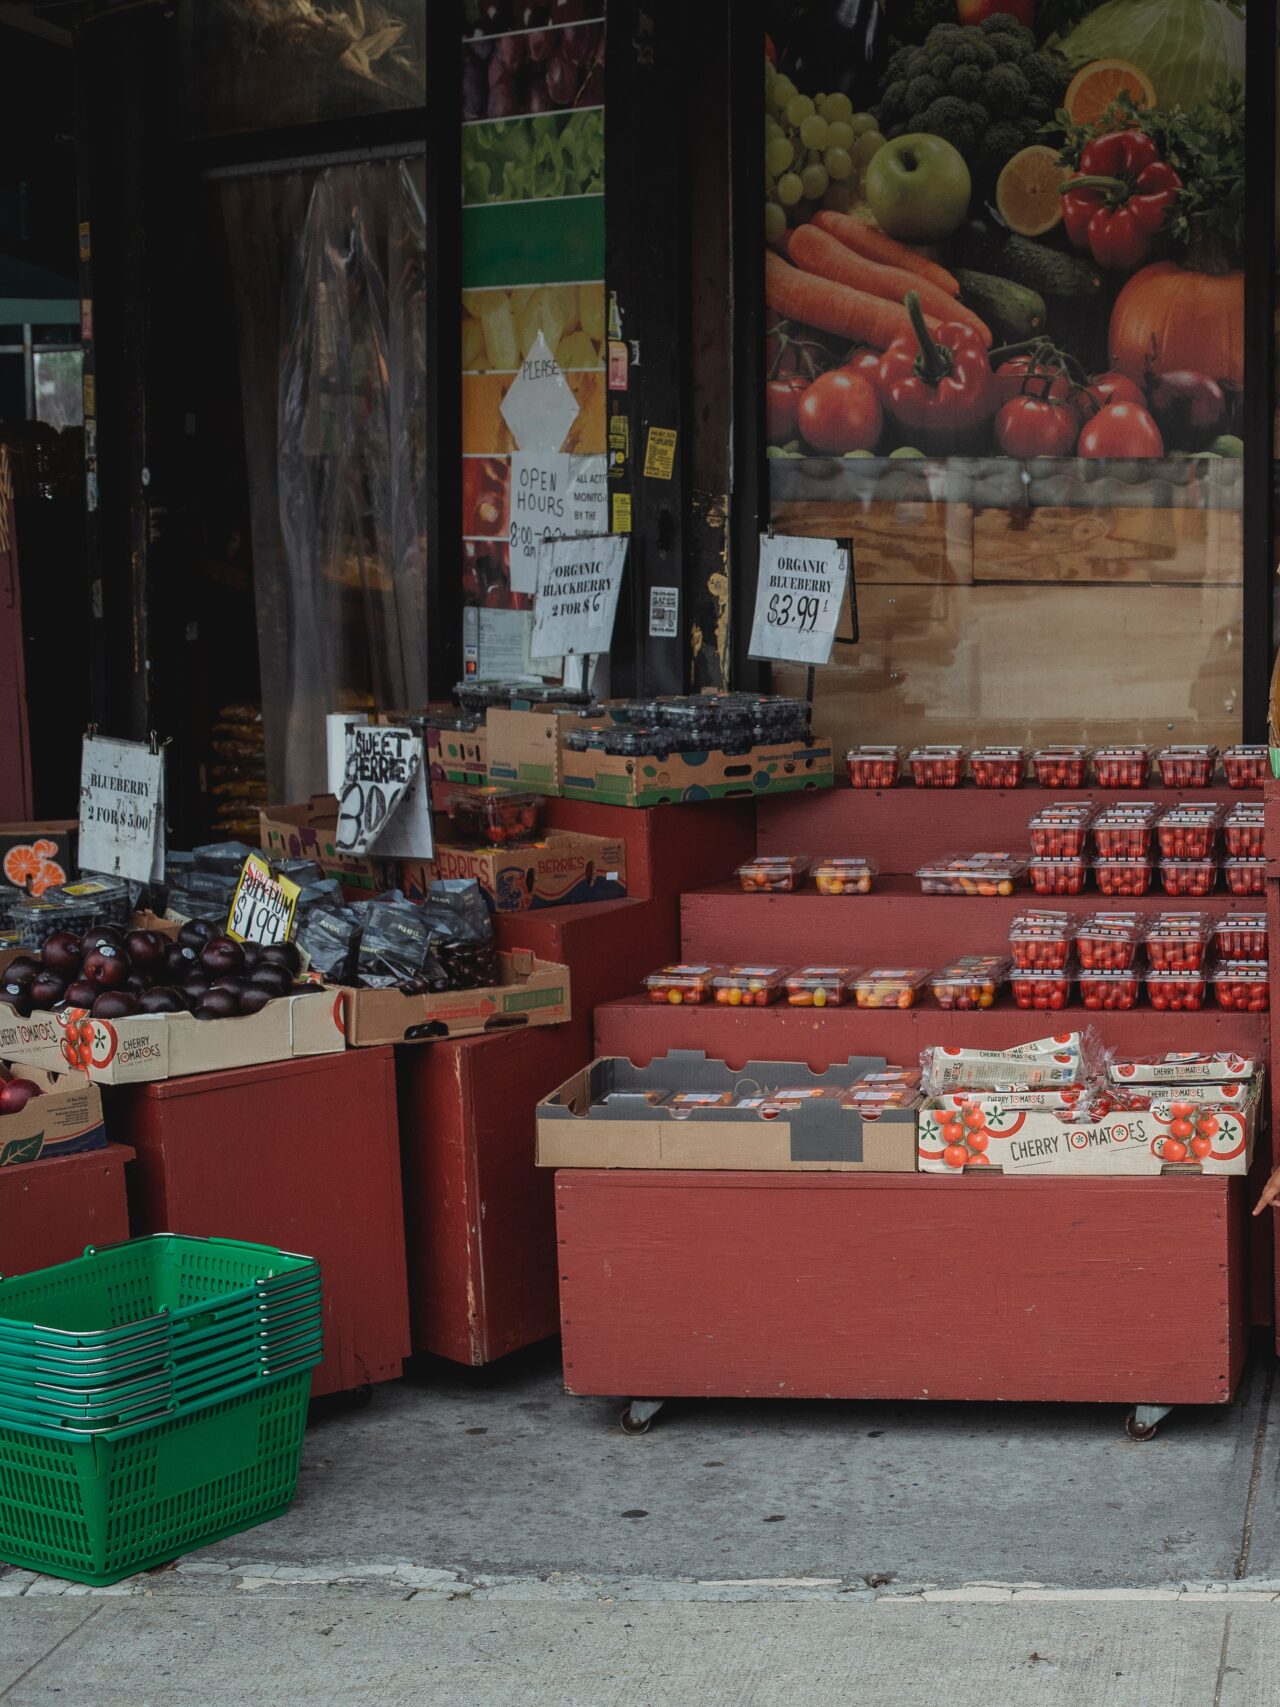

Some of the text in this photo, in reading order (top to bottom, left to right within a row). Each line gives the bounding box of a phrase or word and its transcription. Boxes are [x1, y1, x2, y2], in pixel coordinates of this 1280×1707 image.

[522, 360, 560, 380] PLEASE
[520, 468, 557, 491] OPEN
[575, 474, 589, 484] ALL
[517, 493, 564, 517] HOURS
[574, 511, 596, 521] BY THE
[555, 561, 604, 578] ORGANIC
[777, 557, 828, 574] ORGANIC
[543, 577, 614, 597] BLACKBERRY
[769, 575, 833, 593] BLUEBERRY
[552, 605, 559, 616] 2
[560, 602, 581, 616] FOR
[767, 593, 820, 633] $3.99
[355, 730, 411, 758] SWEET
[91, 773, 150, 797] BLUEBERRY
[88, 806, 94, 820] 2
[96, 807, 119, 825] FOR
[335, 781, 401, 850] 3.0
[538, 856, 585, 875] BERRIES
[17, 1021, 58, 1046] TOMATOES
[123, 1036, 150, 1051] CHERRY
[117, 1044, 161, 1065] TOMATOES
[979, 1051, 1037, 1062] CHERRY TOMATOES
[1153, 1066, 1210, 1076] CHERRY TOMATOES
[987, 1095, 1045, 1104] CHERRY TOMATOES
[1148, 1089, 1204, 1099] CHERRY TOMATOES
[1010, 1120, 1148, 1161] CHERRY TOMATOES
